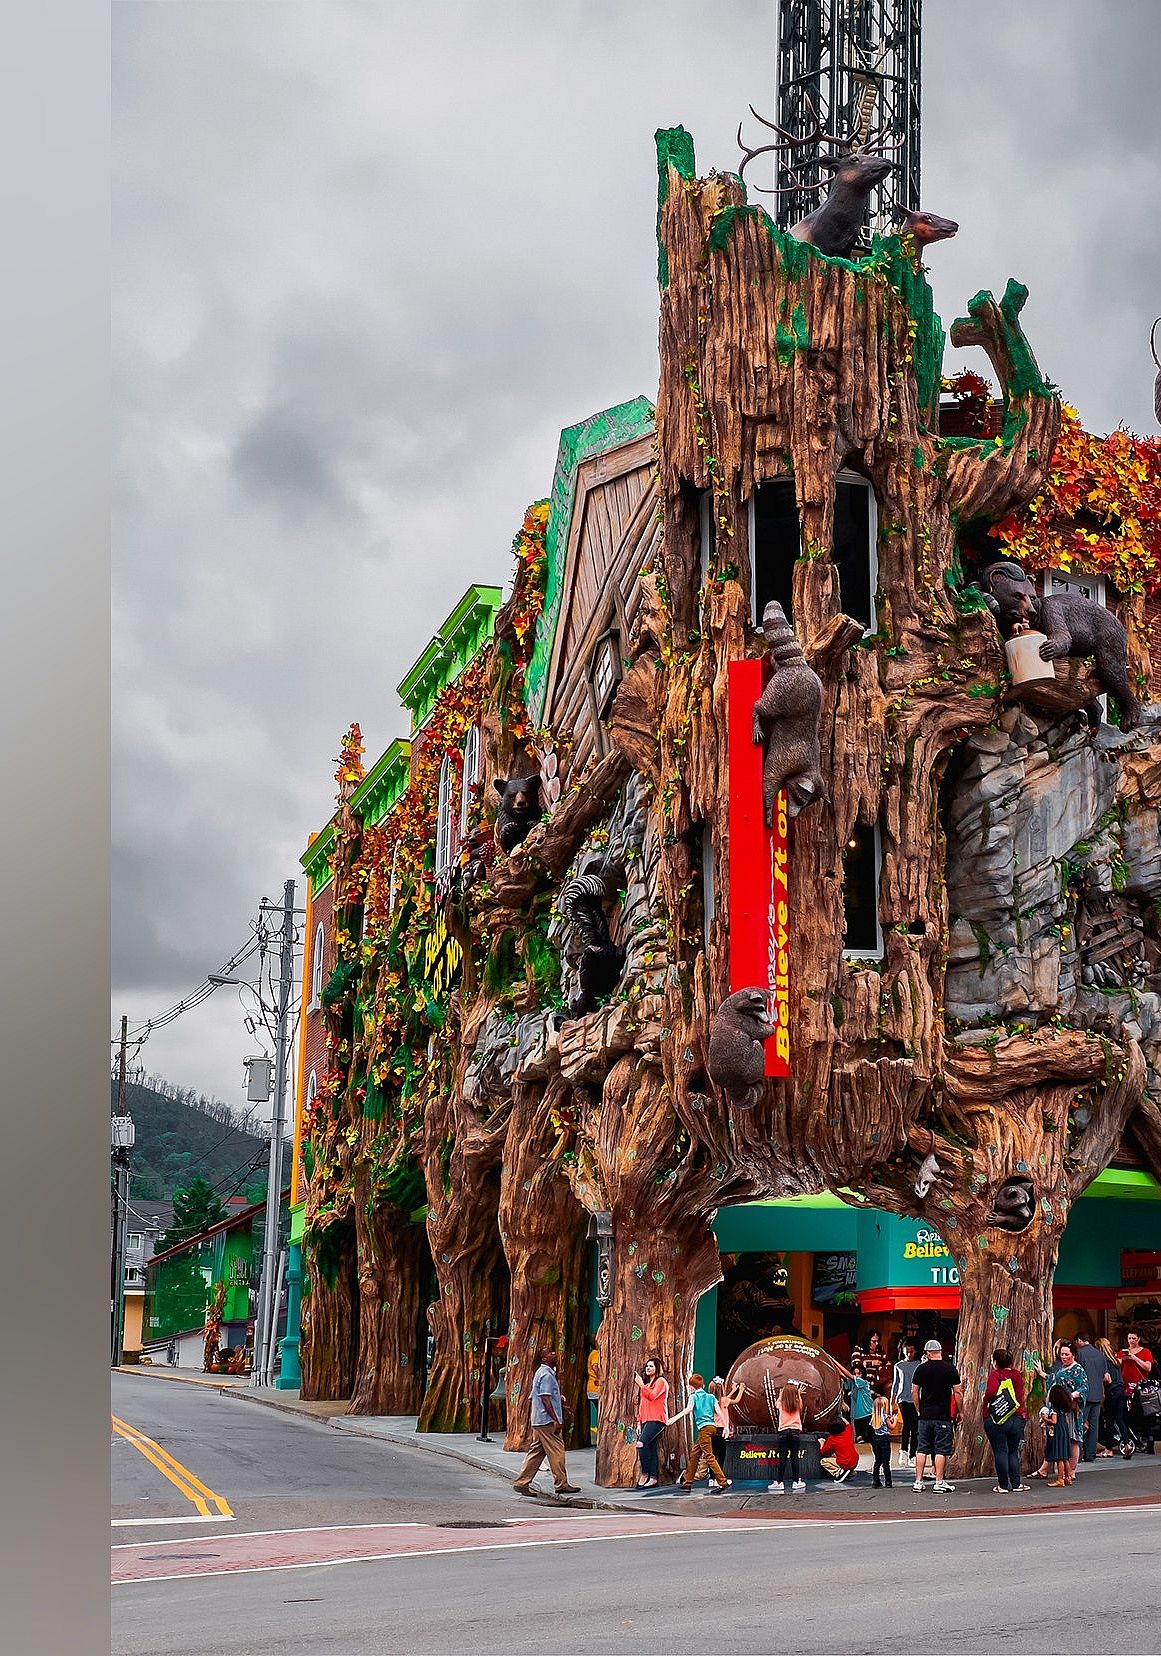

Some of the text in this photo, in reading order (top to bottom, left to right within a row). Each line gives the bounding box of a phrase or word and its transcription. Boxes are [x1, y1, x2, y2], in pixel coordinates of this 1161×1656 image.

[774, 789, 789, 1065] Believe It or
[740, 1450, 767, 1459] Believe
